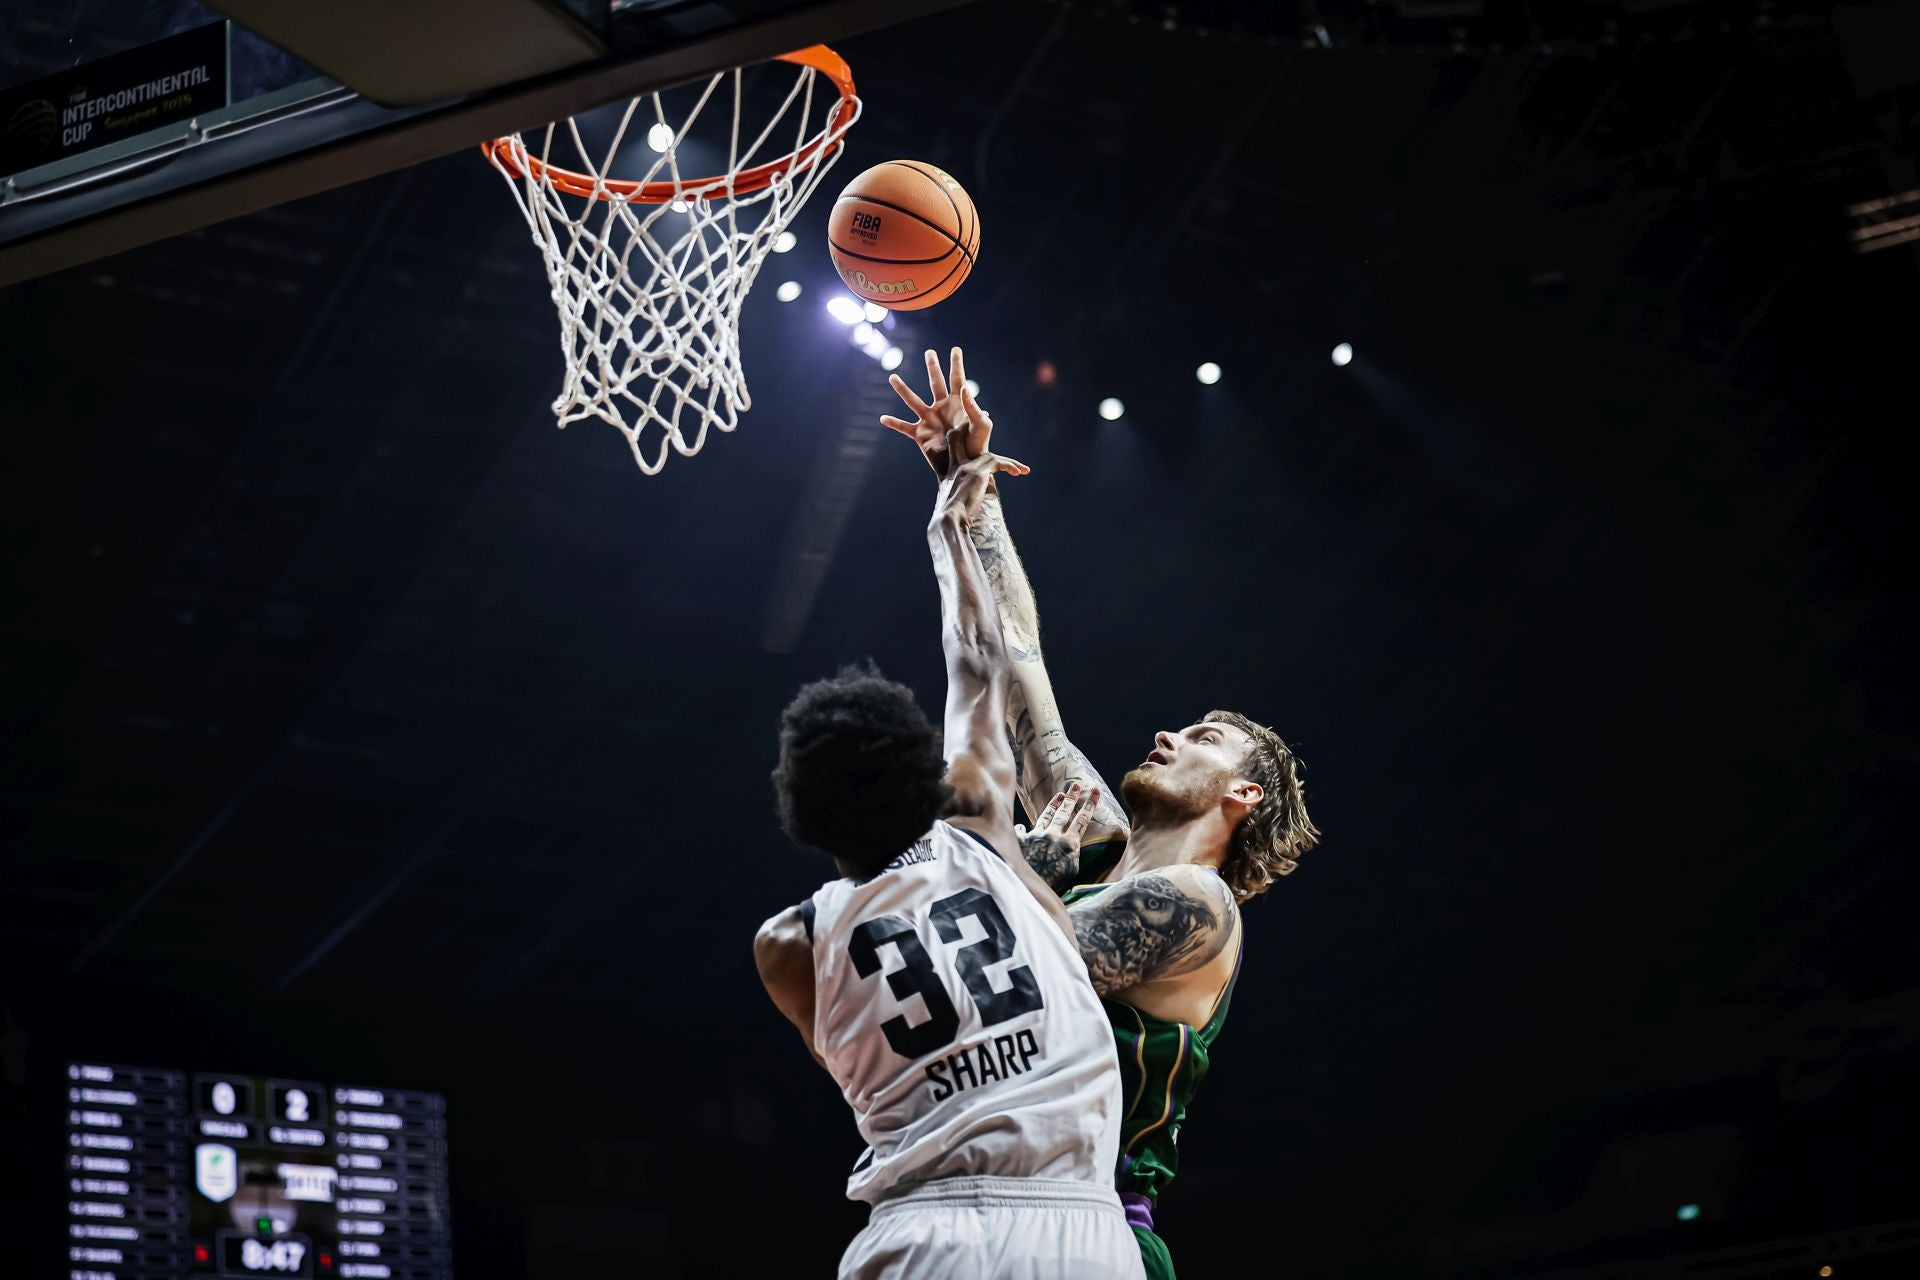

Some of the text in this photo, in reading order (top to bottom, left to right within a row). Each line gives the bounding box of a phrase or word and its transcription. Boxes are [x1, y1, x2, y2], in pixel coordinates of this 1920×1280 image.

[62, 64, 210, 126] INTERCONTINENTAL
[61, 121, 93, 147] CUP
[852, 212, 881, 232] FIBA
[902, 839, 937, 865] LEAGUE
[847, 887, 1044, 1060] 32
[925, 1028, 1040, 1102] SHARP
[286, 1089, 309, 1121] 2
